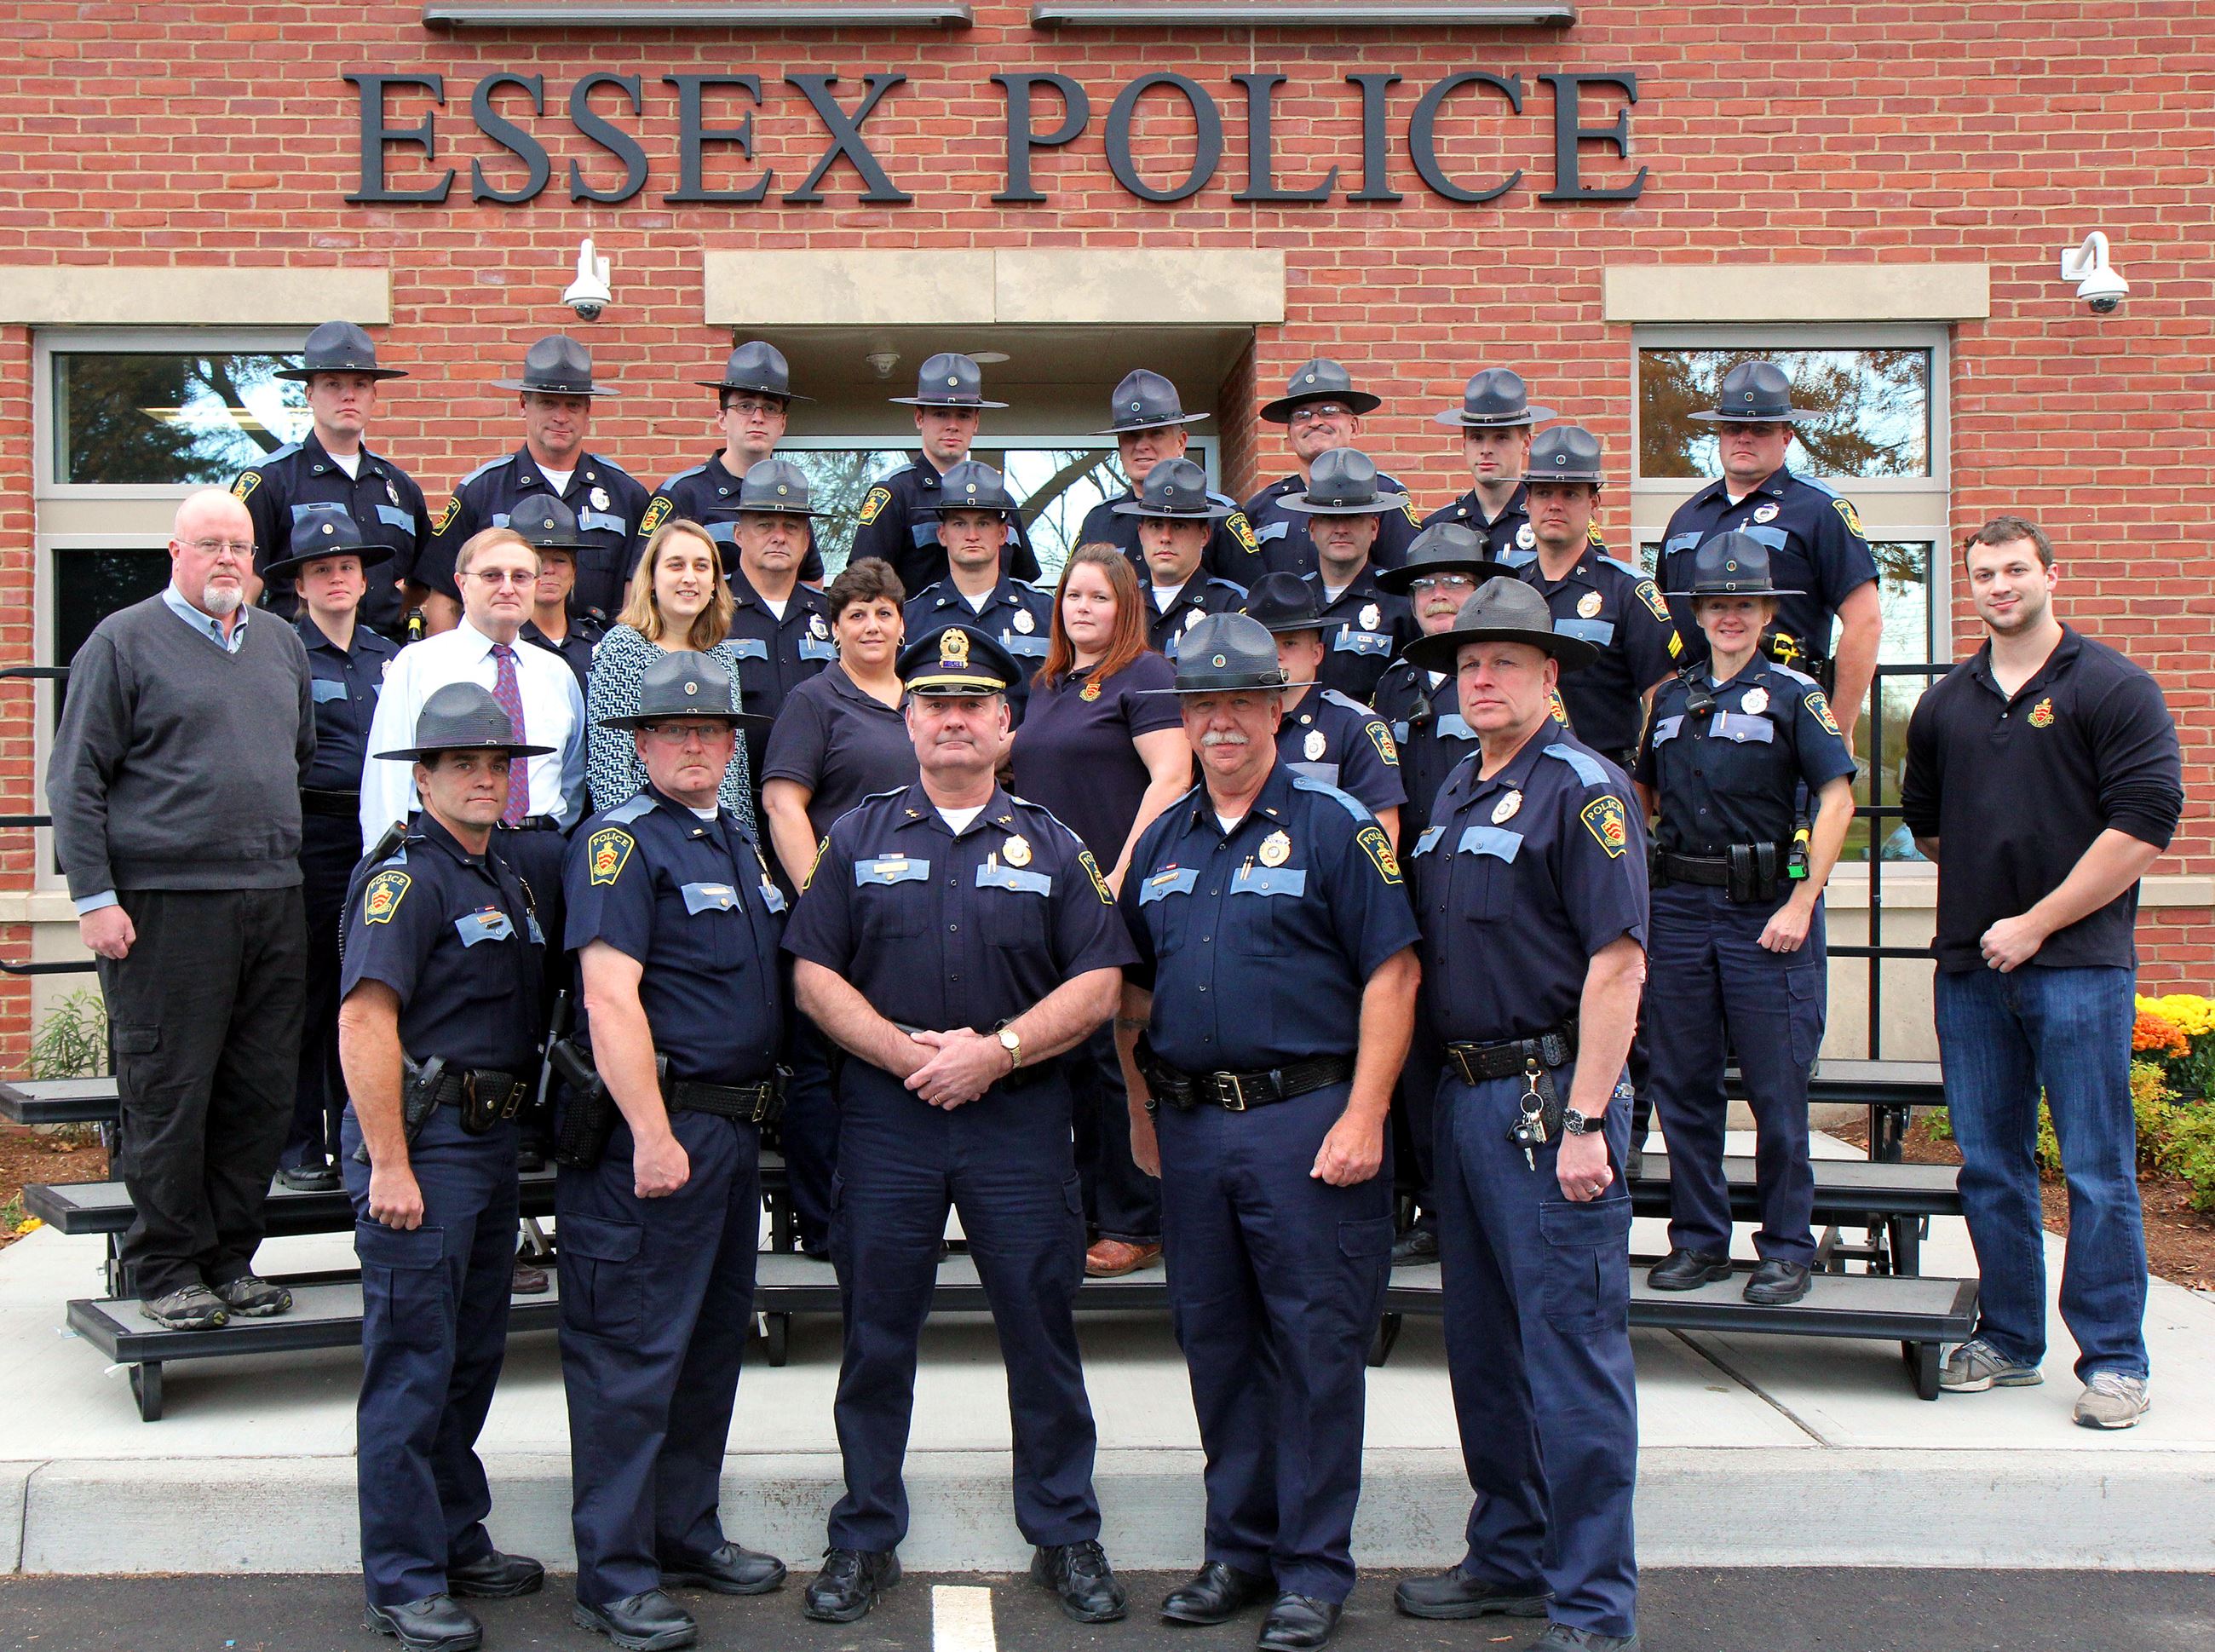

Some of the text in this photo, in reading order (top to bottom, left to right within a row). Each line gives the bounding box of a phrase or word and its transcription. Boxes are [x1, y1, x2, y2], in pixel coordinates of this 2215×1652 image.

[342, 72, 1648, 204] ESSEX POLICE
[592, 832, 629, 848] POLICE
[371, 874, 406, 889] POLICE
